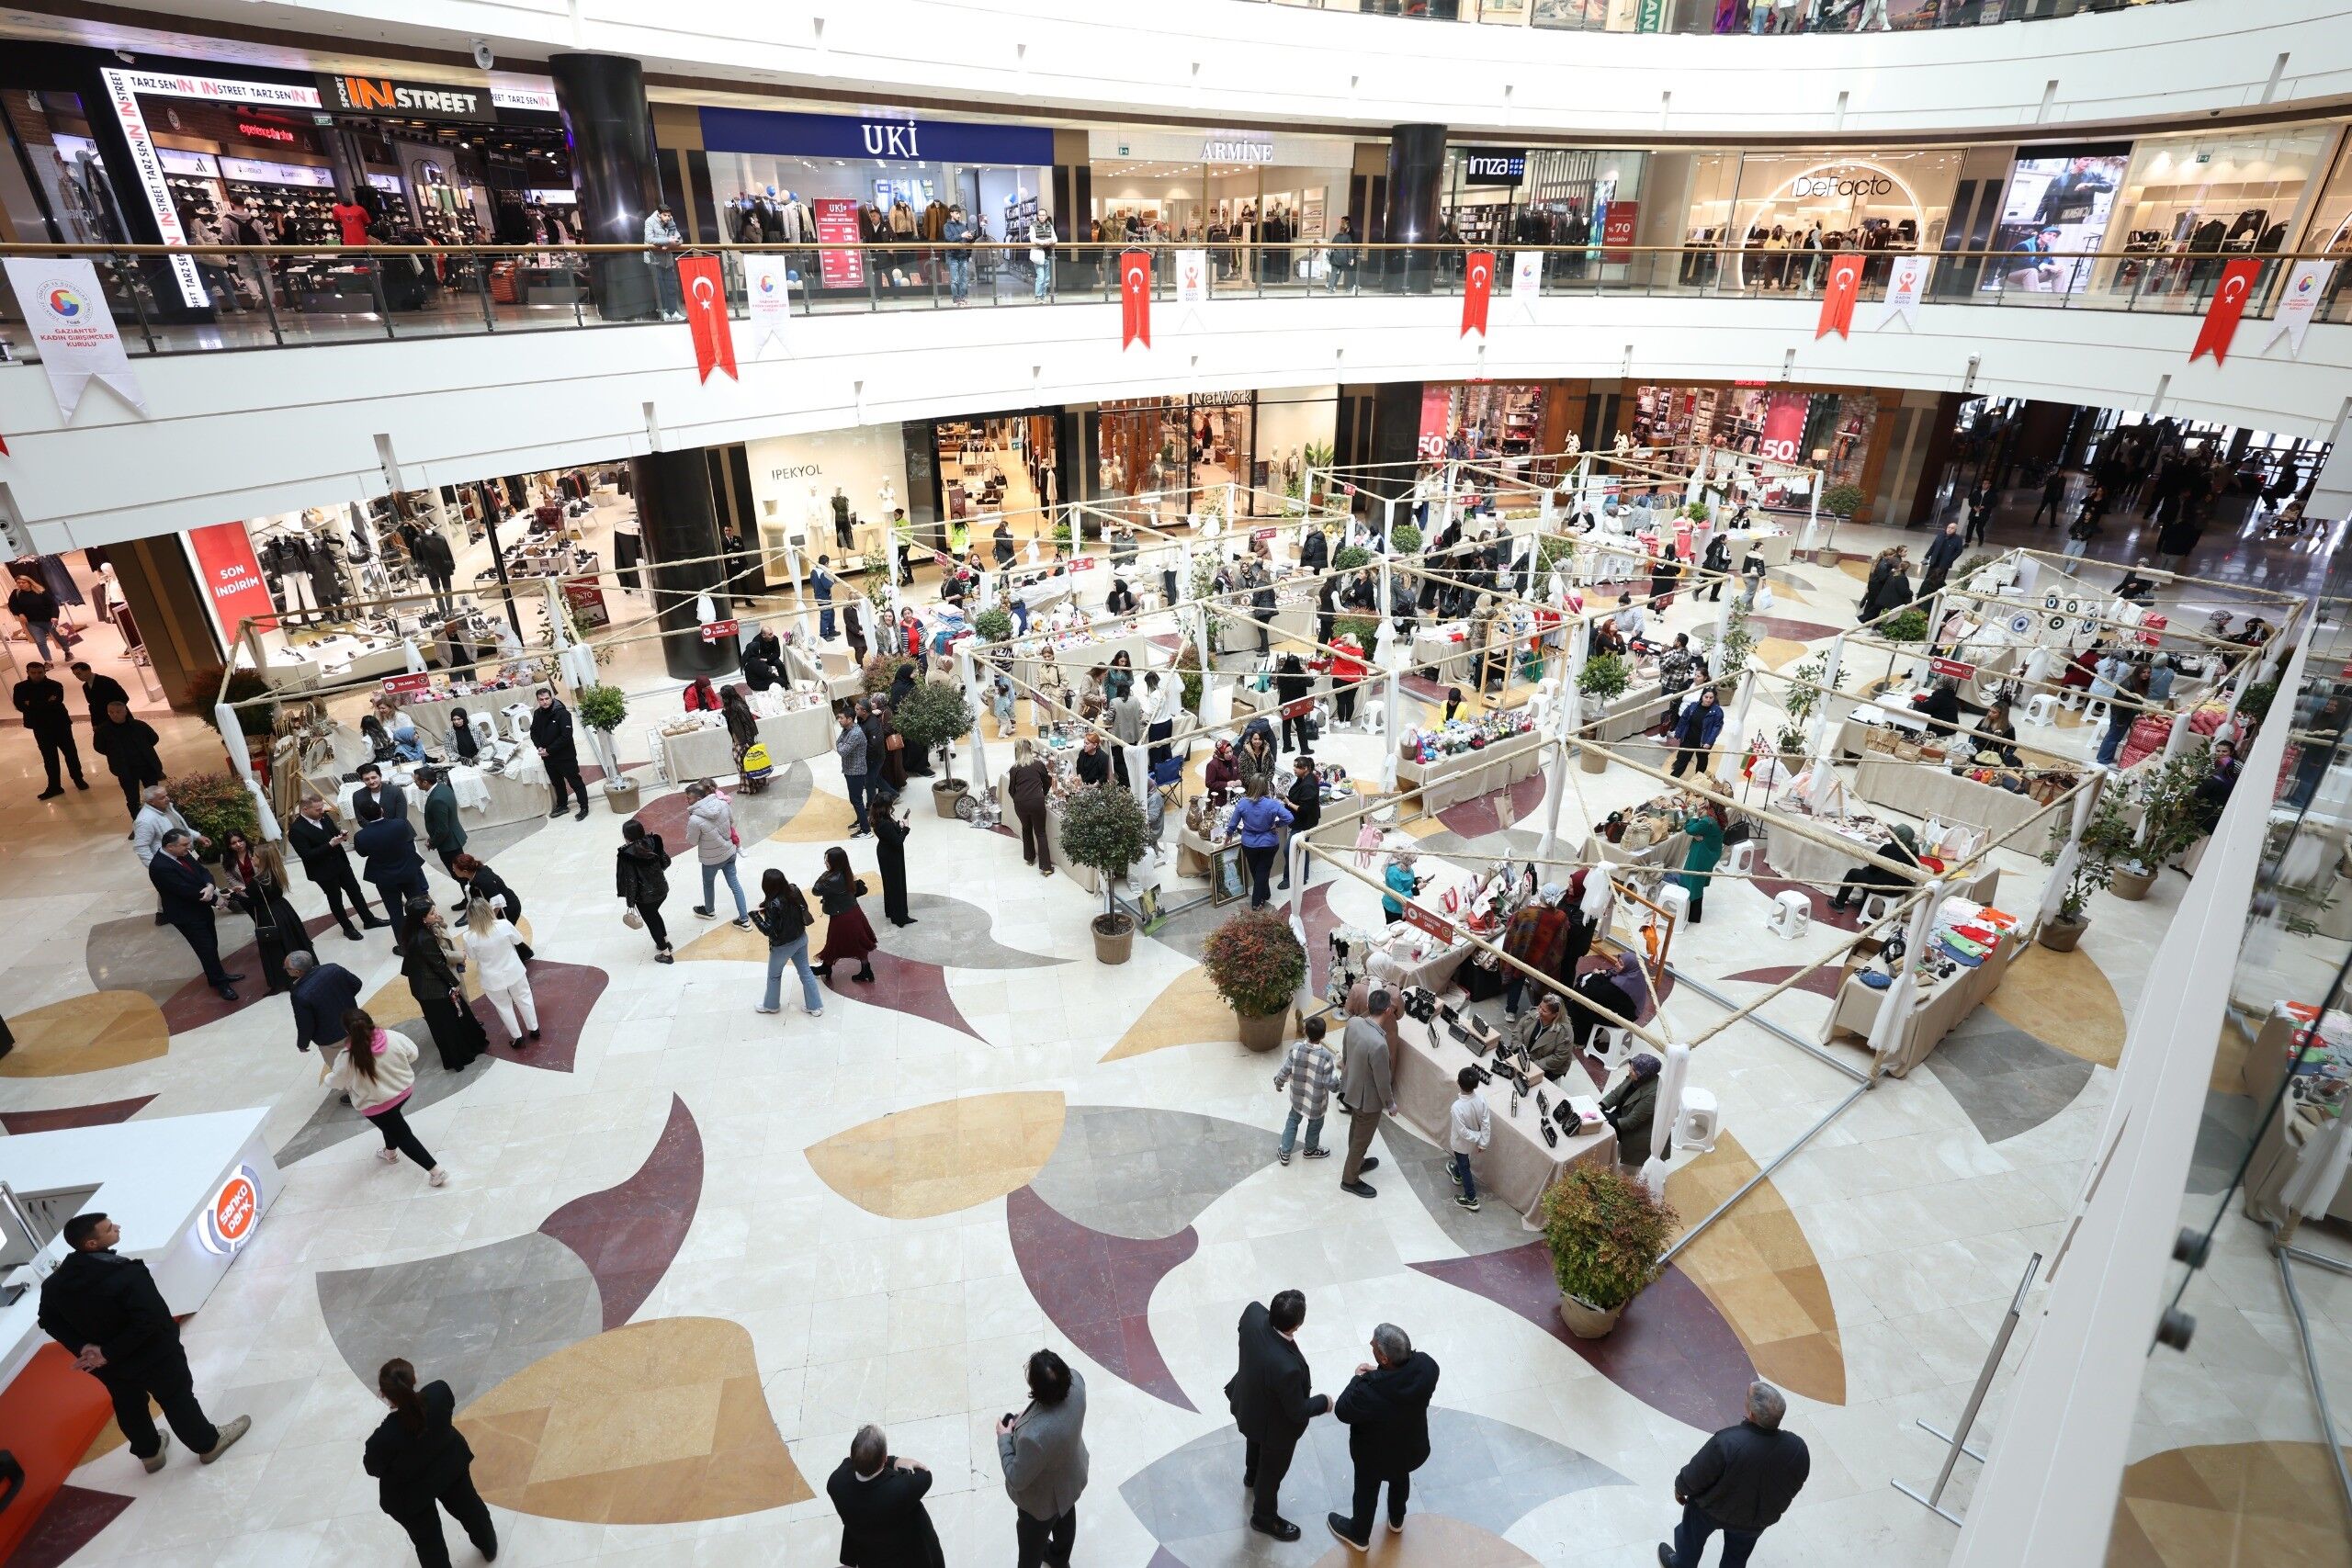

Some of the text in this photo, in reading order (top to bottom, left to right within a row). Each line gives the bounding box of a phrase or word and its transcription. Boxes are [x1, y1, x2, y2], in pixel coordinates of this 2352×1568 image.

[130, 76, 157, 89] TARZ
[250, 87, 275, 98] TARZ
[334, 76, 350, 108] SPORT
[507, 94, 525, 104] TARZ
[861, 120, 919, 158] UKİ
[1201, 140, 1273, 163] ARMİNE
[141, 159, 158, 181] TARZ
[1469, 156, 1508, 175] imza
[1796, 175, 1892, 197] DeFacto
[183, 267, 196, 288] TARZ
[1192, 390, 1250, 404] NetWork
[220, 564, 245, 580] SON
